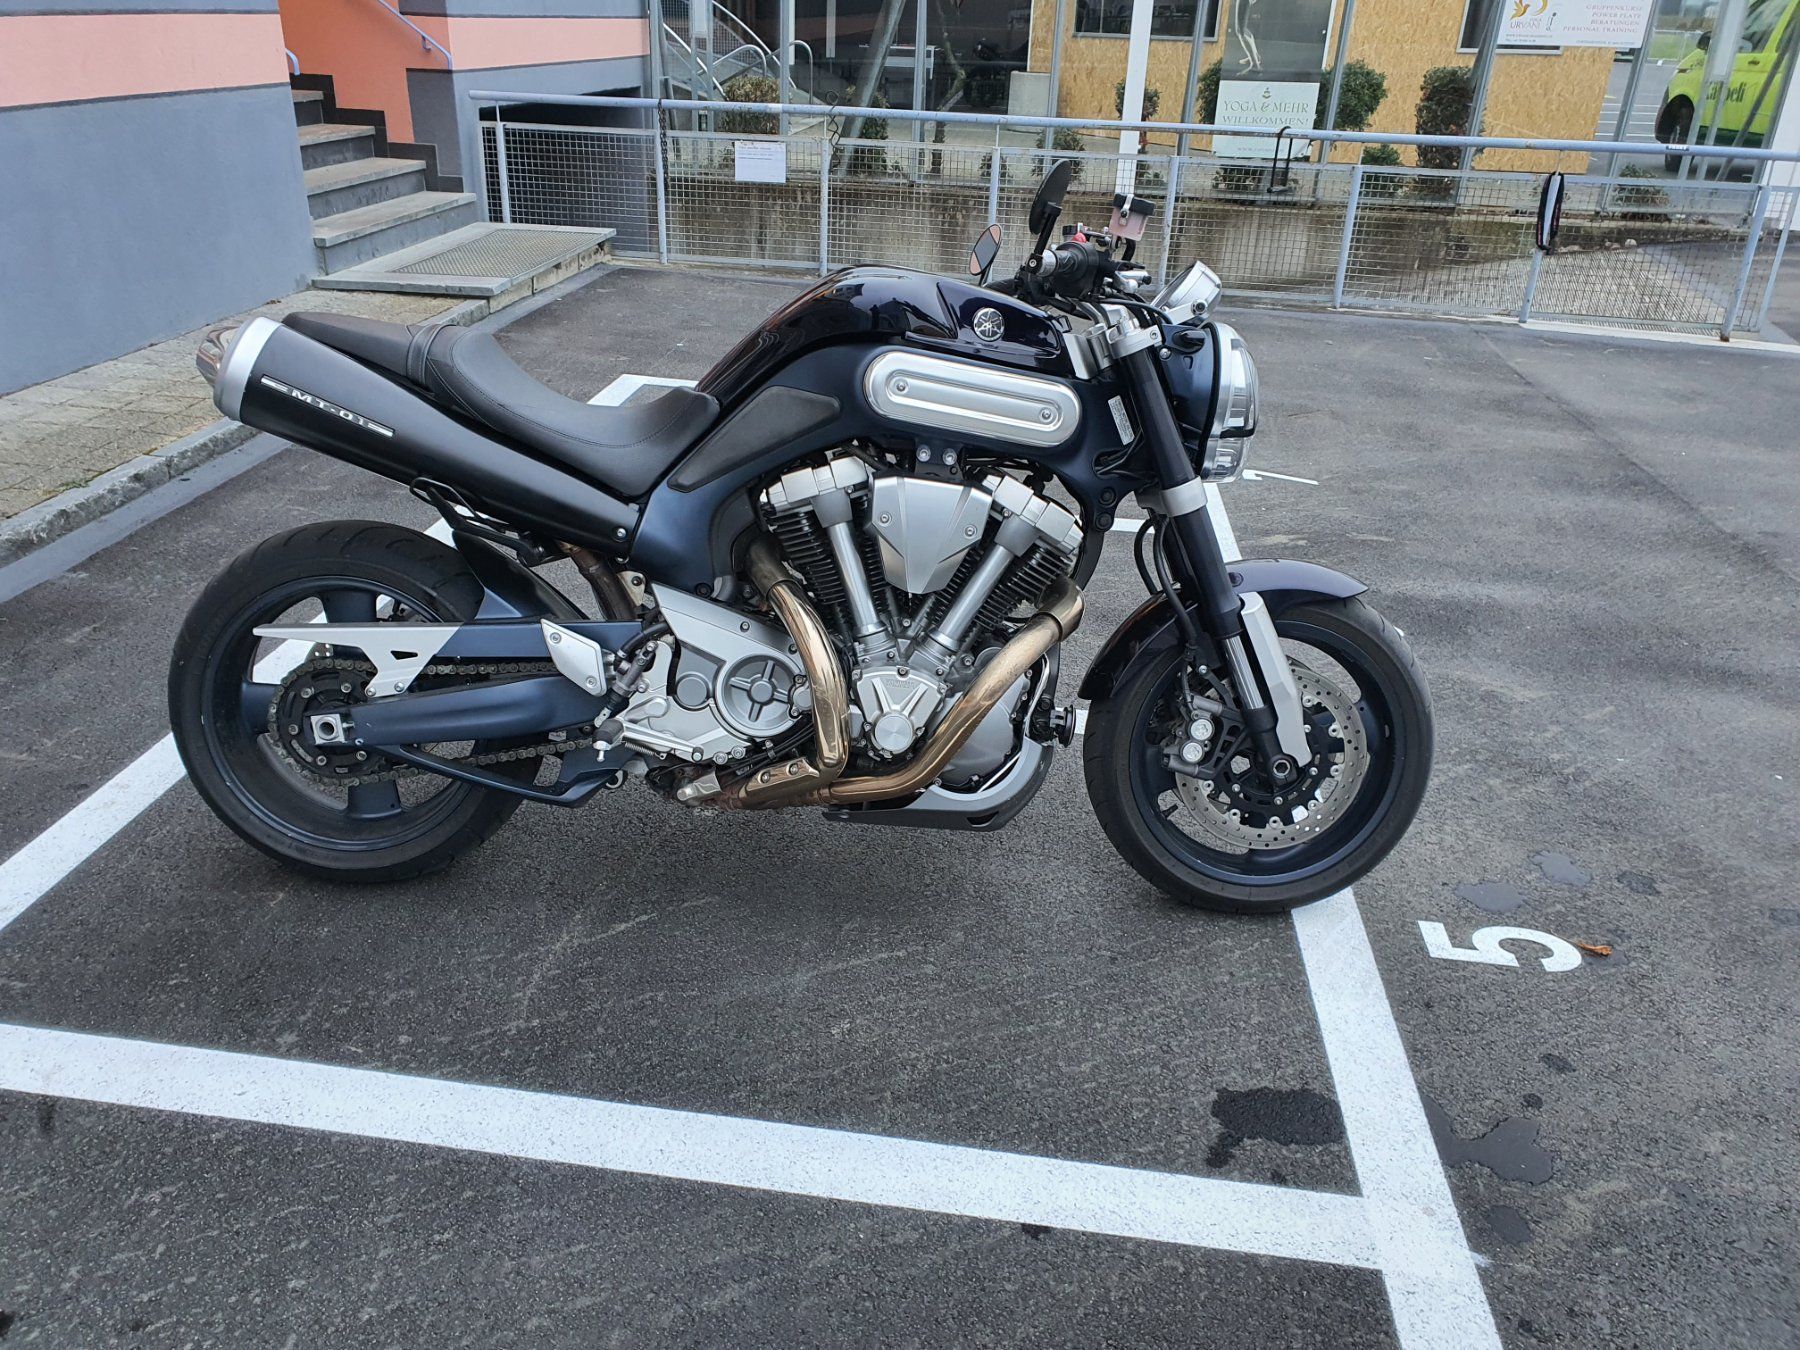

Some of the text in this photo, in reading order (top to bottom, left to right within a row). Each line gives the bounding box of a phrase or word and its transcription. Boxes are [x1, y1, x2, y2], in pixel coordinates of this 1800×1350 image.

[1224, 101, 1309, 113] YOGA & MEHR
[1223, 115, 1309, 125] WILLKOMMEN!
[291, 389, 364, 426] MT-01
[1417, 920, 1582, 972] 5
